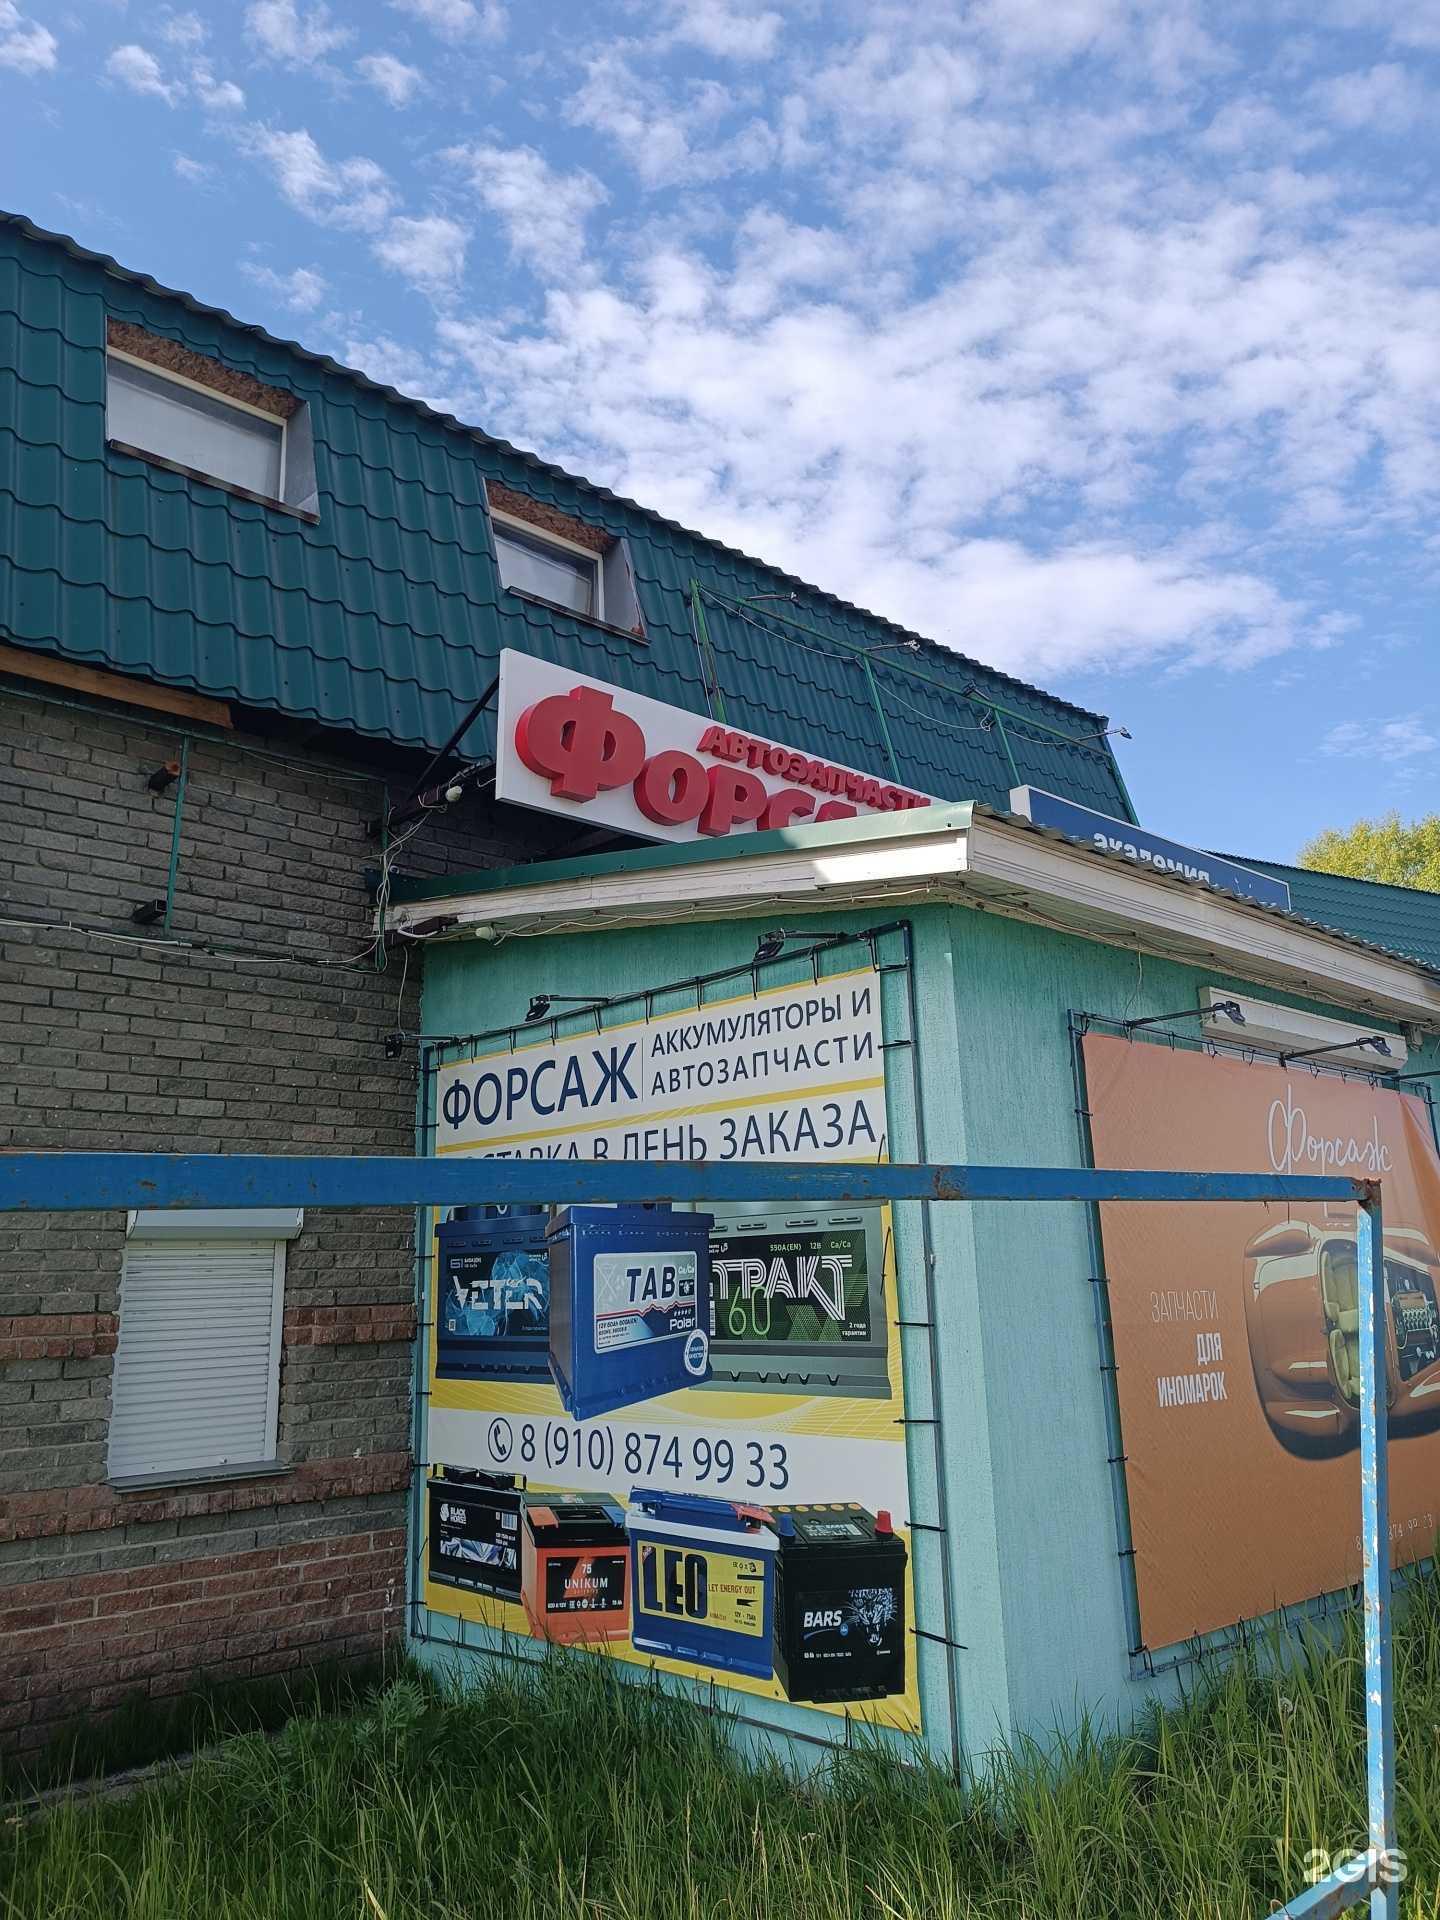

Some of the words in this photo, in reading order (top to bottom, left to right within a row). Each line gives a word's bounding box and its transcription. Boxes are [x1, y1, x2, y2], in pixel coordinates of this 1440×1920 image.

[651, 993, 842, 1058] АККУМУЛЯТОРЫ
[852, 987, 872, 1017] И
[651, 1031, 874, 1096] АВТОЗАПЧАСТИ
[442, 1042, 638, 1130] ФОРСАЖ
[720, 1099, 877, 1161] ЗАКАЗА
[1268, 1083, 1393, 1176] Форсаж
[452, 1275, 543, 1310] VETER
[626, 1266, 677, 1302] TAB
[669, 1317, 695, 1331] Polar
[728, 1284, 770, 1336] 60
[1151, 1290, 1219, 1323] ЗАПЧАСТИ
[1196, 1332, 1223, 1366] ДЛЯ
[1157, 1371, 1227, 1408] ИНОМАРОК
[521, 1423, 536, 1463] 8
[544, 1421, 614, 1476] (910)
[624, 1432, 683, 1479] 874
[692, 1437, 734, 1484] 99
[746, 1441, 790, 1491] 33
[564, 1577, 609, 1590] UNIKUM
[642, 1546, 708, 1619] LEO
[708, 1583, 718, 1592] LET
[720, 1584, 743, 1594] ENERGY
[803, 1609, 843, 1628] BARS
